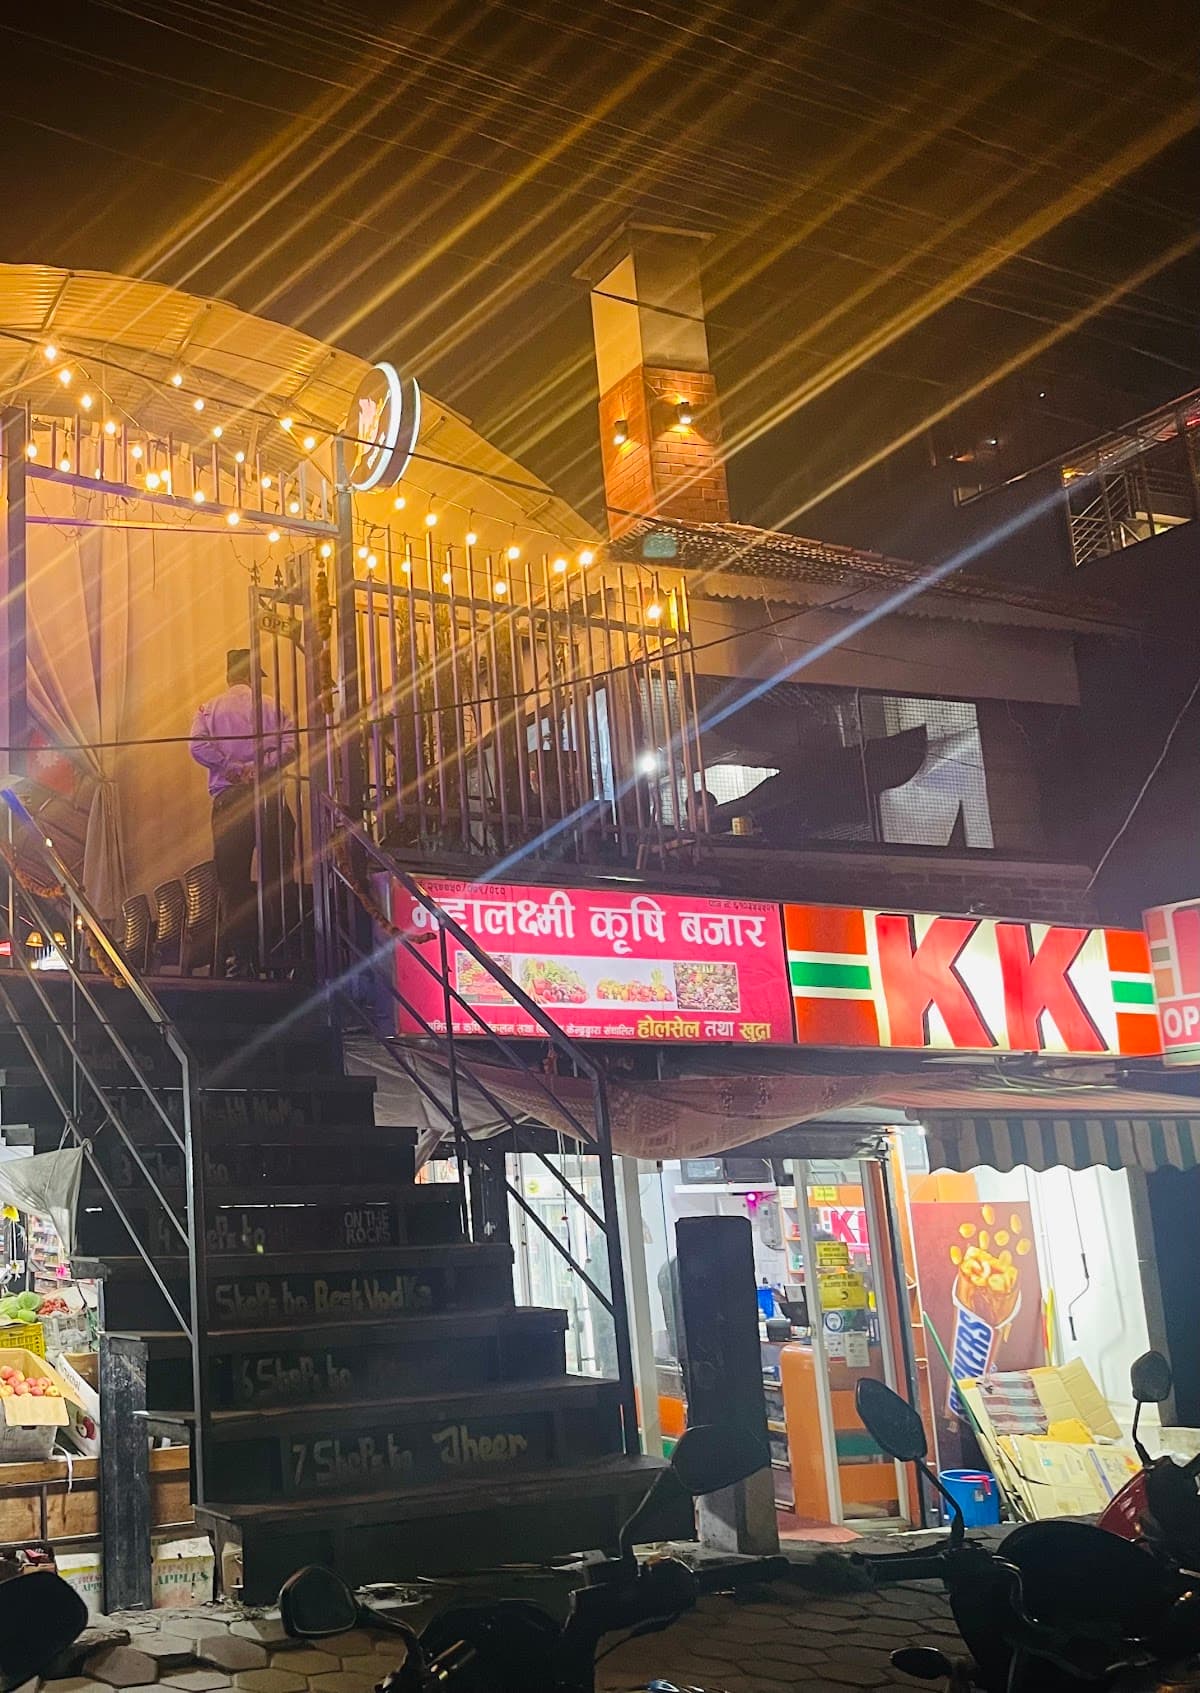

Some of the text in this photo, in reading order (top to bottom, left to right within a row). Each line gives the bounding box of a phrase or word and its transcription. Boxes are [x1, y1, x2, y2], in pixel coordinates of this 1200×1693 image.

[262, 615, 296, 634] OPE
[587, 896, 665, 954] कृषि
[677, 911, 765, 947] बजार
[875, 912, 1110, 1054] KK
[637, 1015, 700, 1038] होलसेल
[704, 1020, 735, 1038] तथा
[738, 1022, 772, 1042] खुद्रा
[156, 1571, 209, 1585] APPLES
